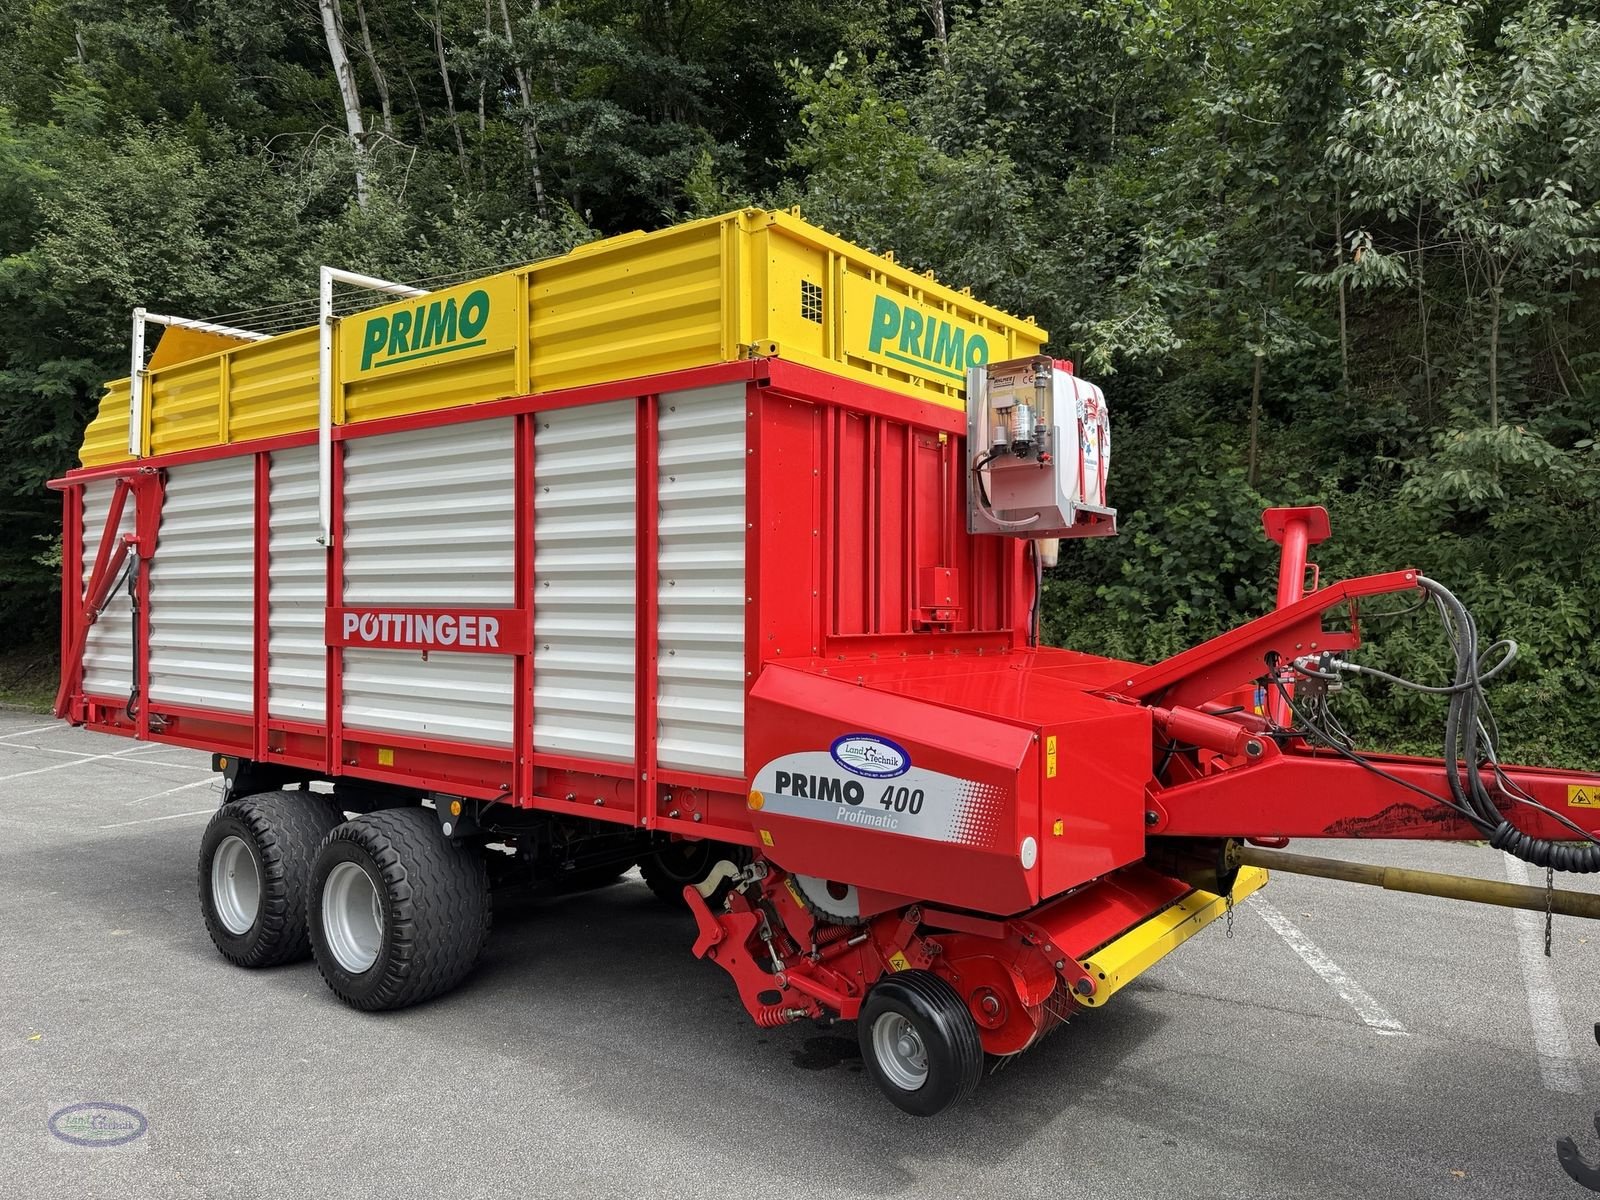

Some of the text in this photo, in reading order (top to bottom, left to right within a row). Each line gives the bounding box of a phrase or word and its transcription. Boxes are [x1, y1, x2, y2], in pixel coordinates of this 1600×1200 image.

[360, 290, 490, 371] PRIMO
[868, 294, 989, 371] PRIMO
[845, 744, 864, 755] Land
[869, 753, 899, 767] Technik
[775, 770, 925, 815] PRIMO 400
[836, 807, 899, 830] Profimatic
